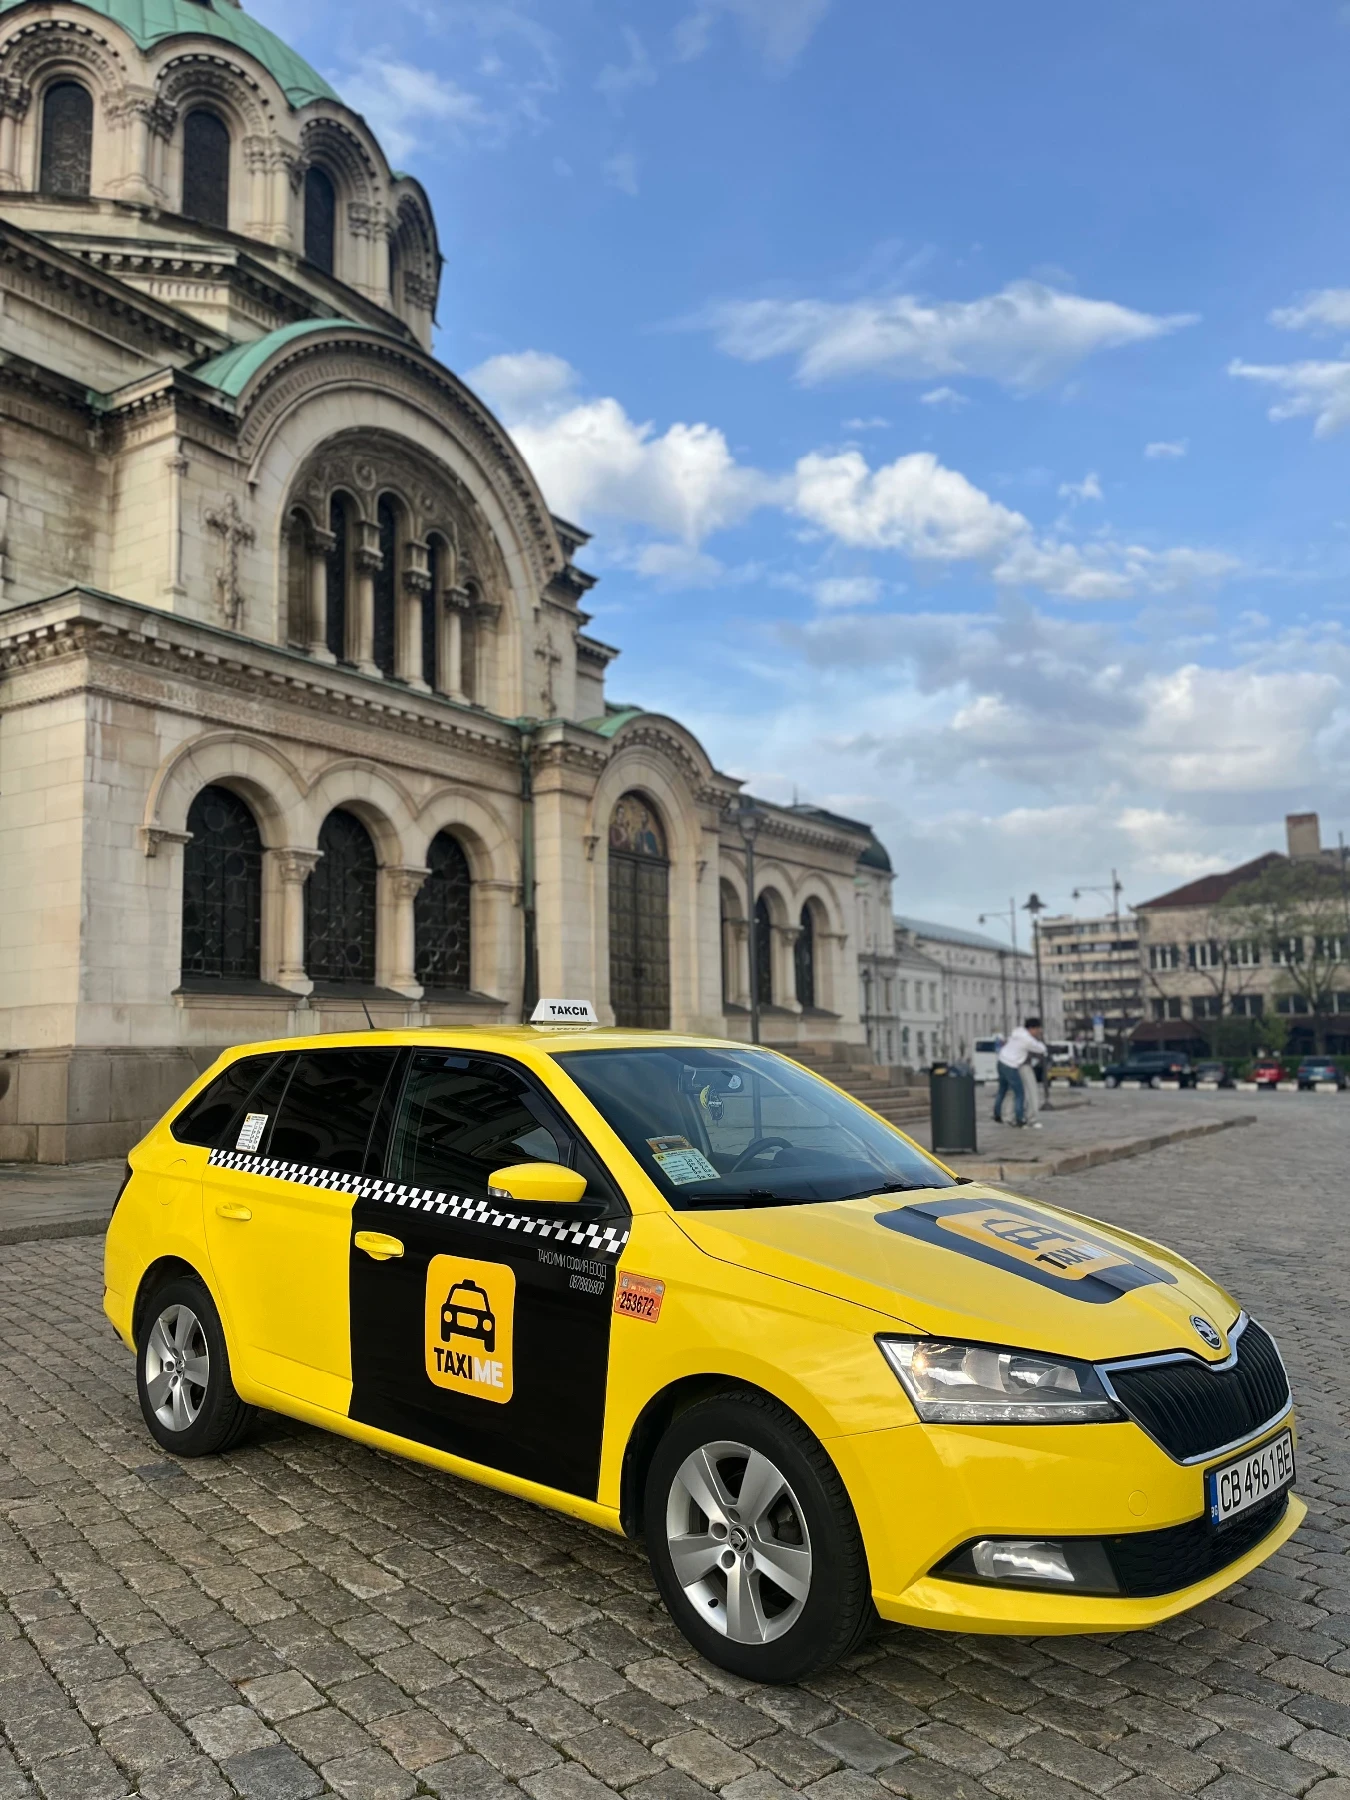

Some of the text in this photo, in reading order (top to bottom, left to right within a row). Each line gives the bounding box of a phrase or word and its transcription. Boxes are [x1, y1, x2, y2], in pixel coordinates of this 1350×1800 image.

[549, 1005, 589, 1015] ТАКСИ
[566, 1255, 589, 1274] СОФИЯ
[589, 1260, 607, 1281] ЕООД
[619, 1291, 655, 1316] 253672
[433, 1346, 504, 1389] TAXIME
